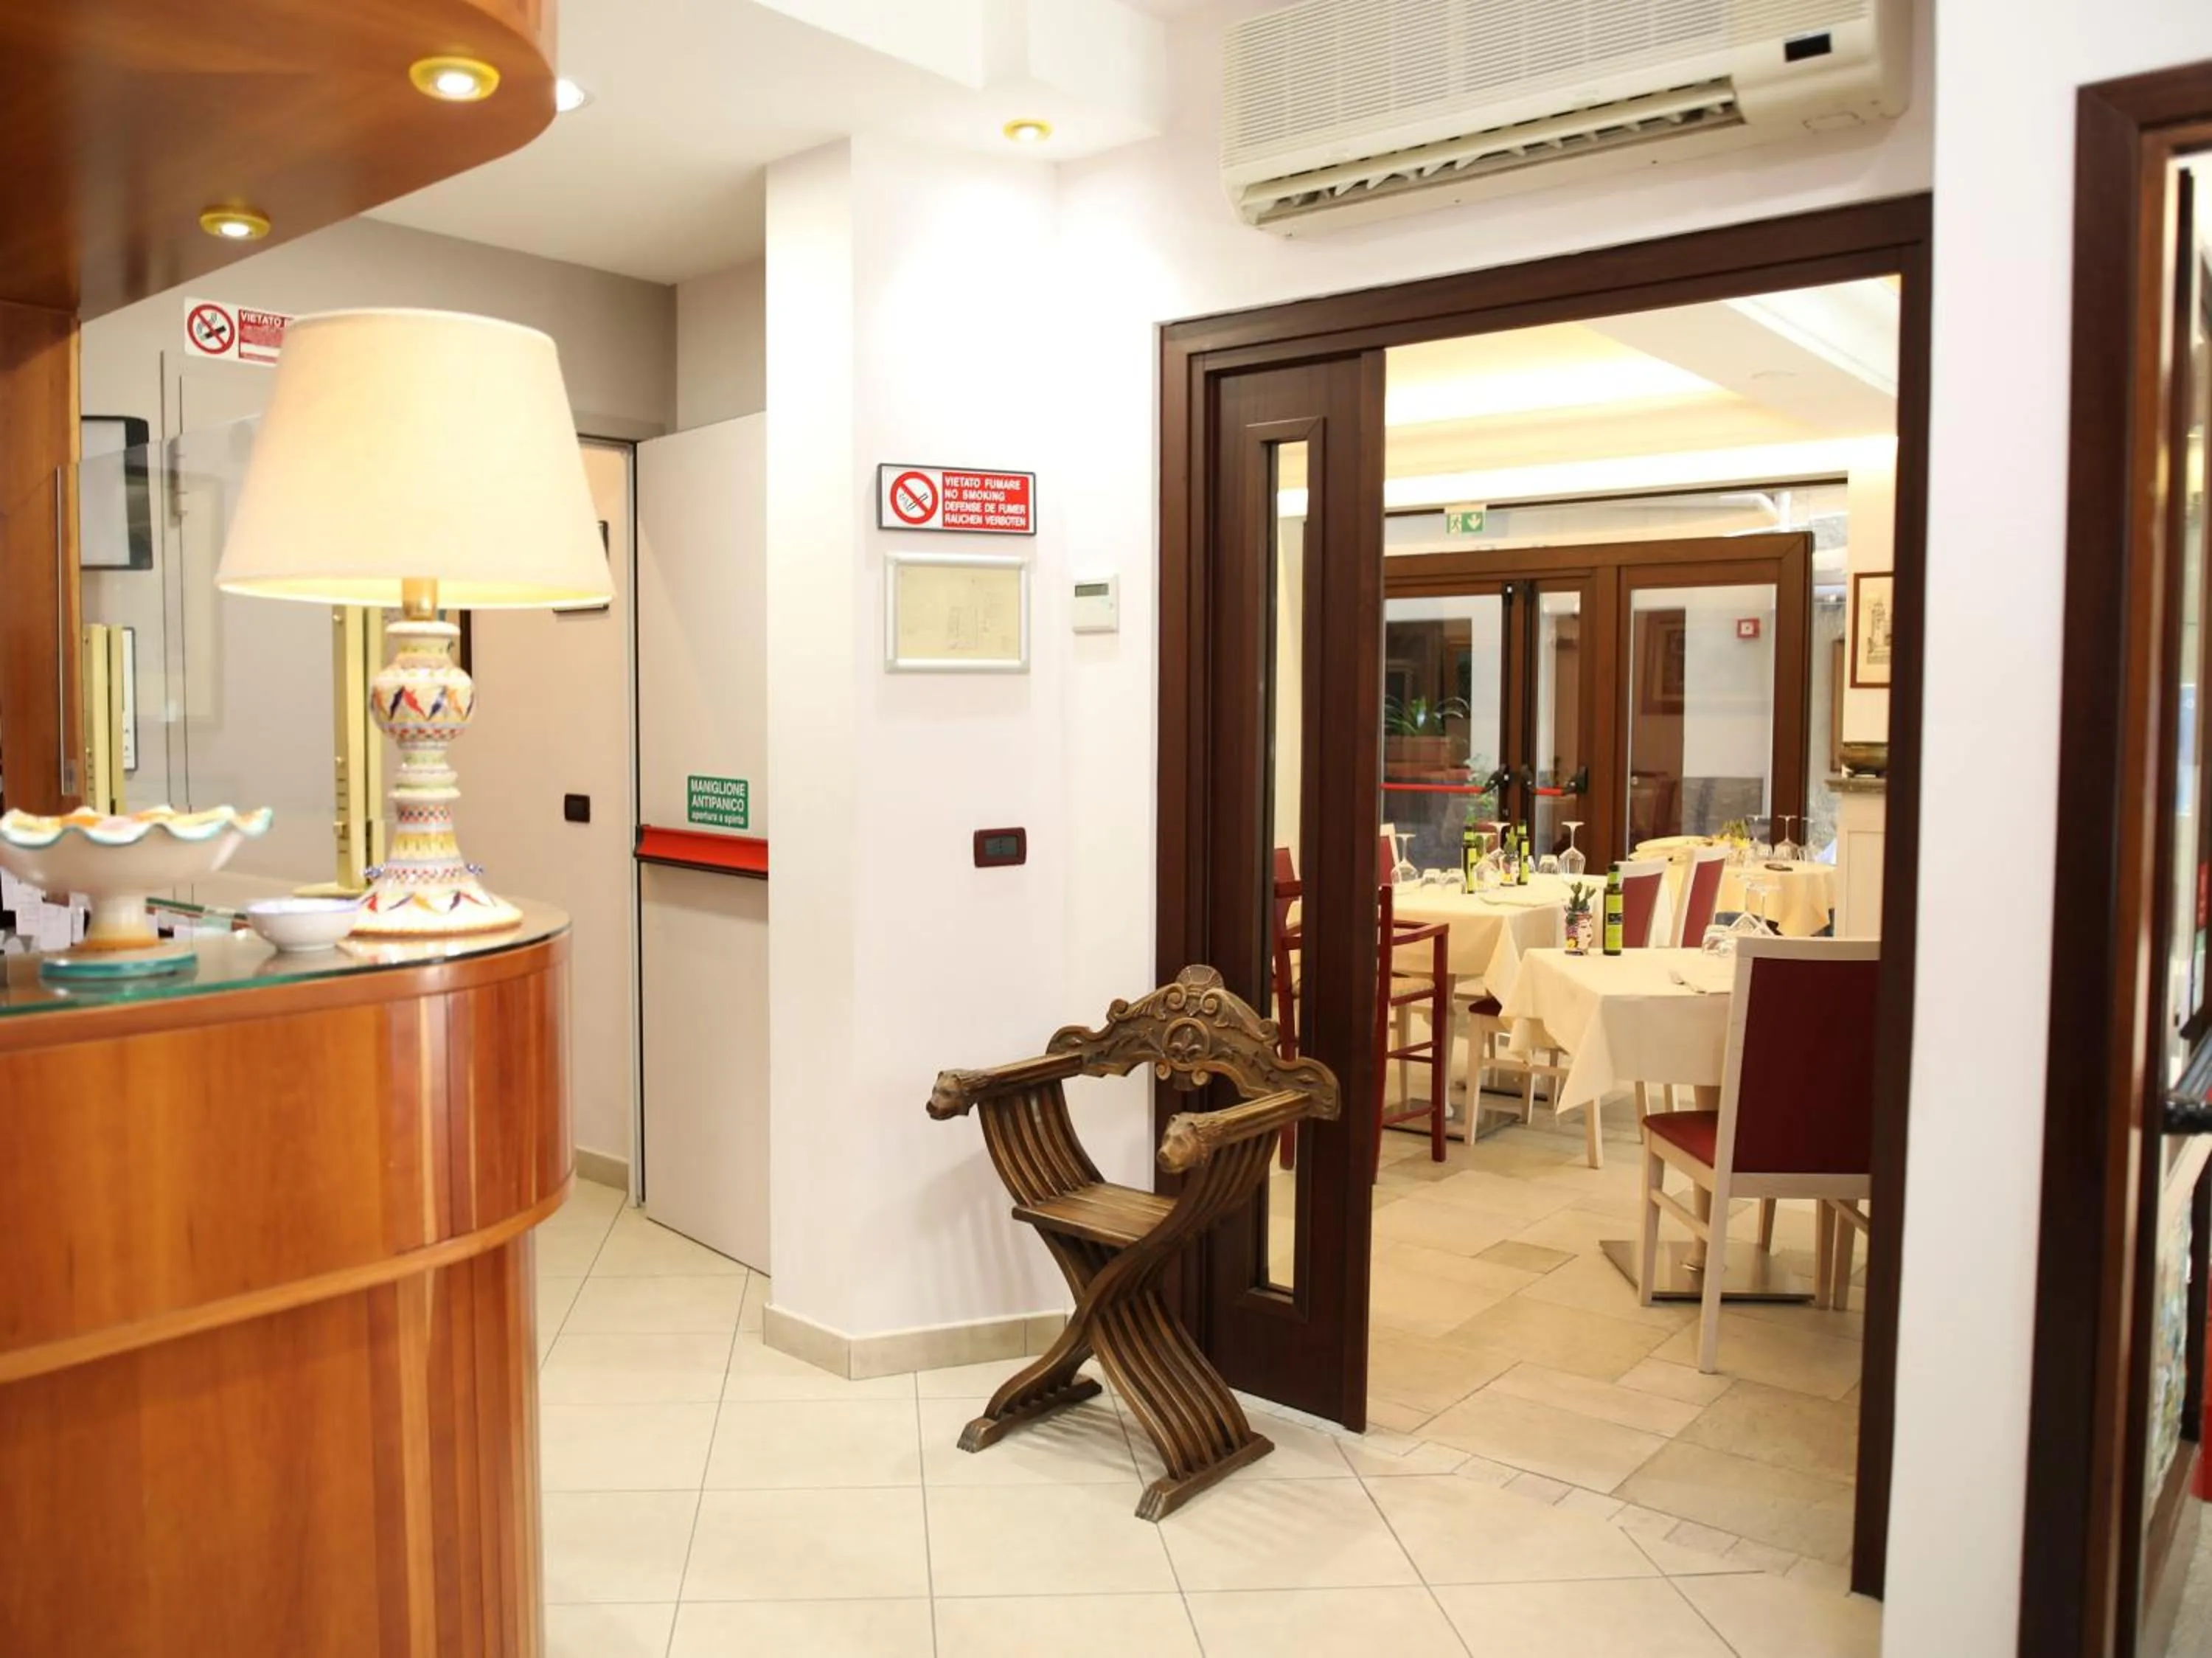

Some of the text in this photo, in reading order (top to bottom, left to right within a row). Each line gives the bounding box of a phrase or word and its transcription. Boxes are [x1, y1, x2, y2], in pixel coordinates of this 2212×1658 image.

[945, 477, 1021, 490] VIETATO FUMARE
[945, 488, 1005, 502] NO SMOKING
[945, 501, 1026, 514] DEFENSE DE FUMER
[945, 513, 1026, 527] RAUCHEN VERBOTEN
[692, 794, 744, 812] ANTIPANICO
